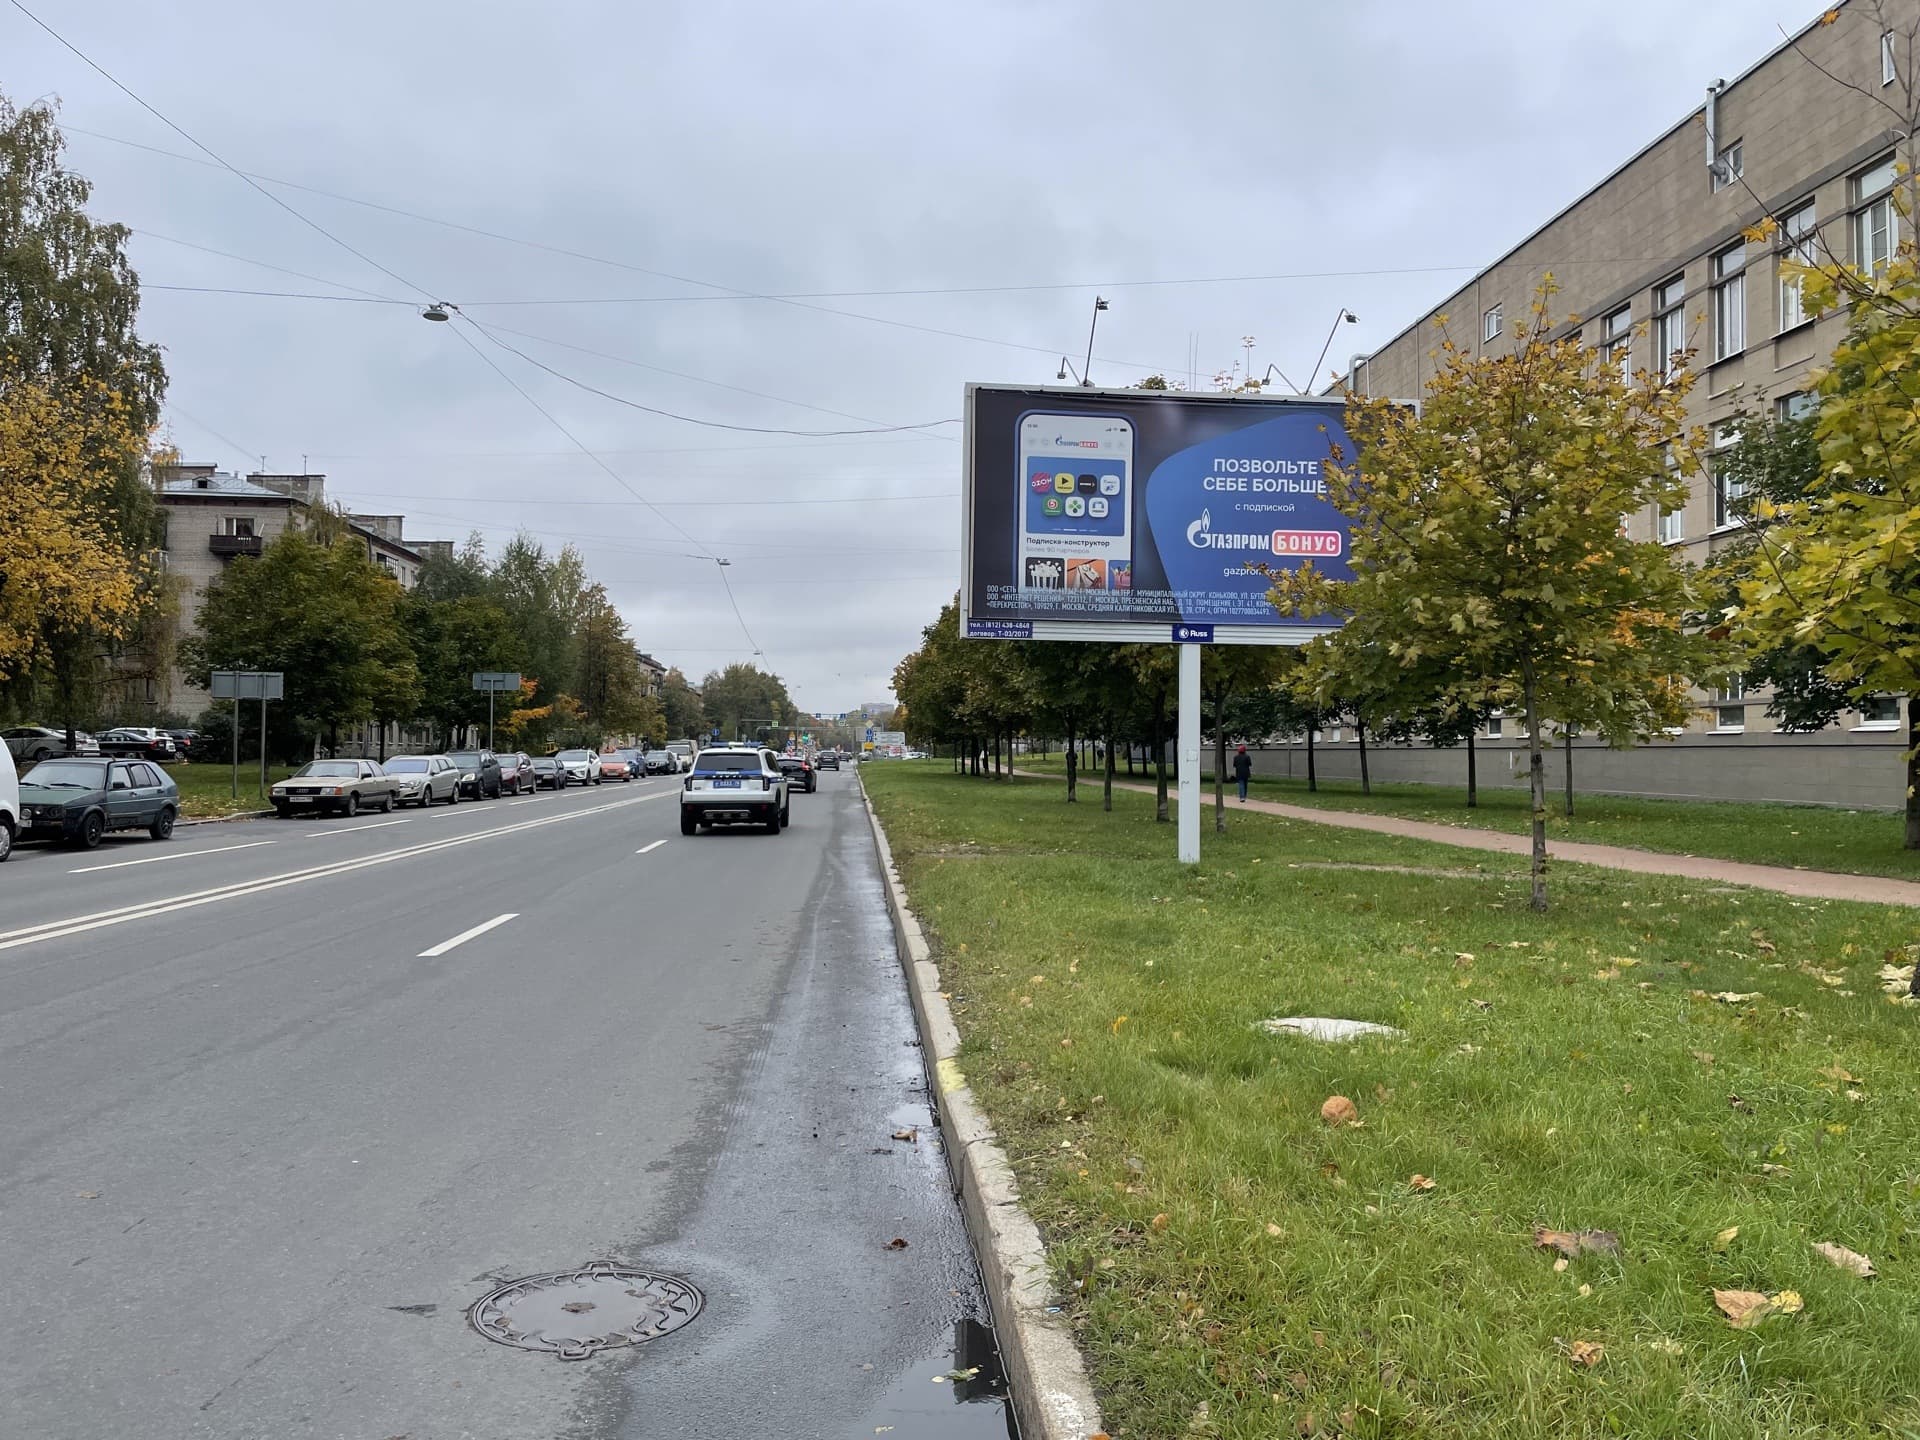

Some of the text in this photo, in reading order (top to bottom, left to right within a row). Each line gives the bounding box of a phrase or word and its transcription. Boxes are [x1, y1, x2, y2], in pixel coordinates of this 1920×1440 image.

[1213, 458, 1318, 475] ПОЗВОЛЬТЕ
[1203, 477, 1327, 494] СЕБЕ БОЛЬШЕ
[1234, 503, 1295, 513] с подпиской
[1026, 537, 1110, 547] Подписка-конструктор
[1211, 533, 1337, 551] ГАЗПРОМ БОНУС
